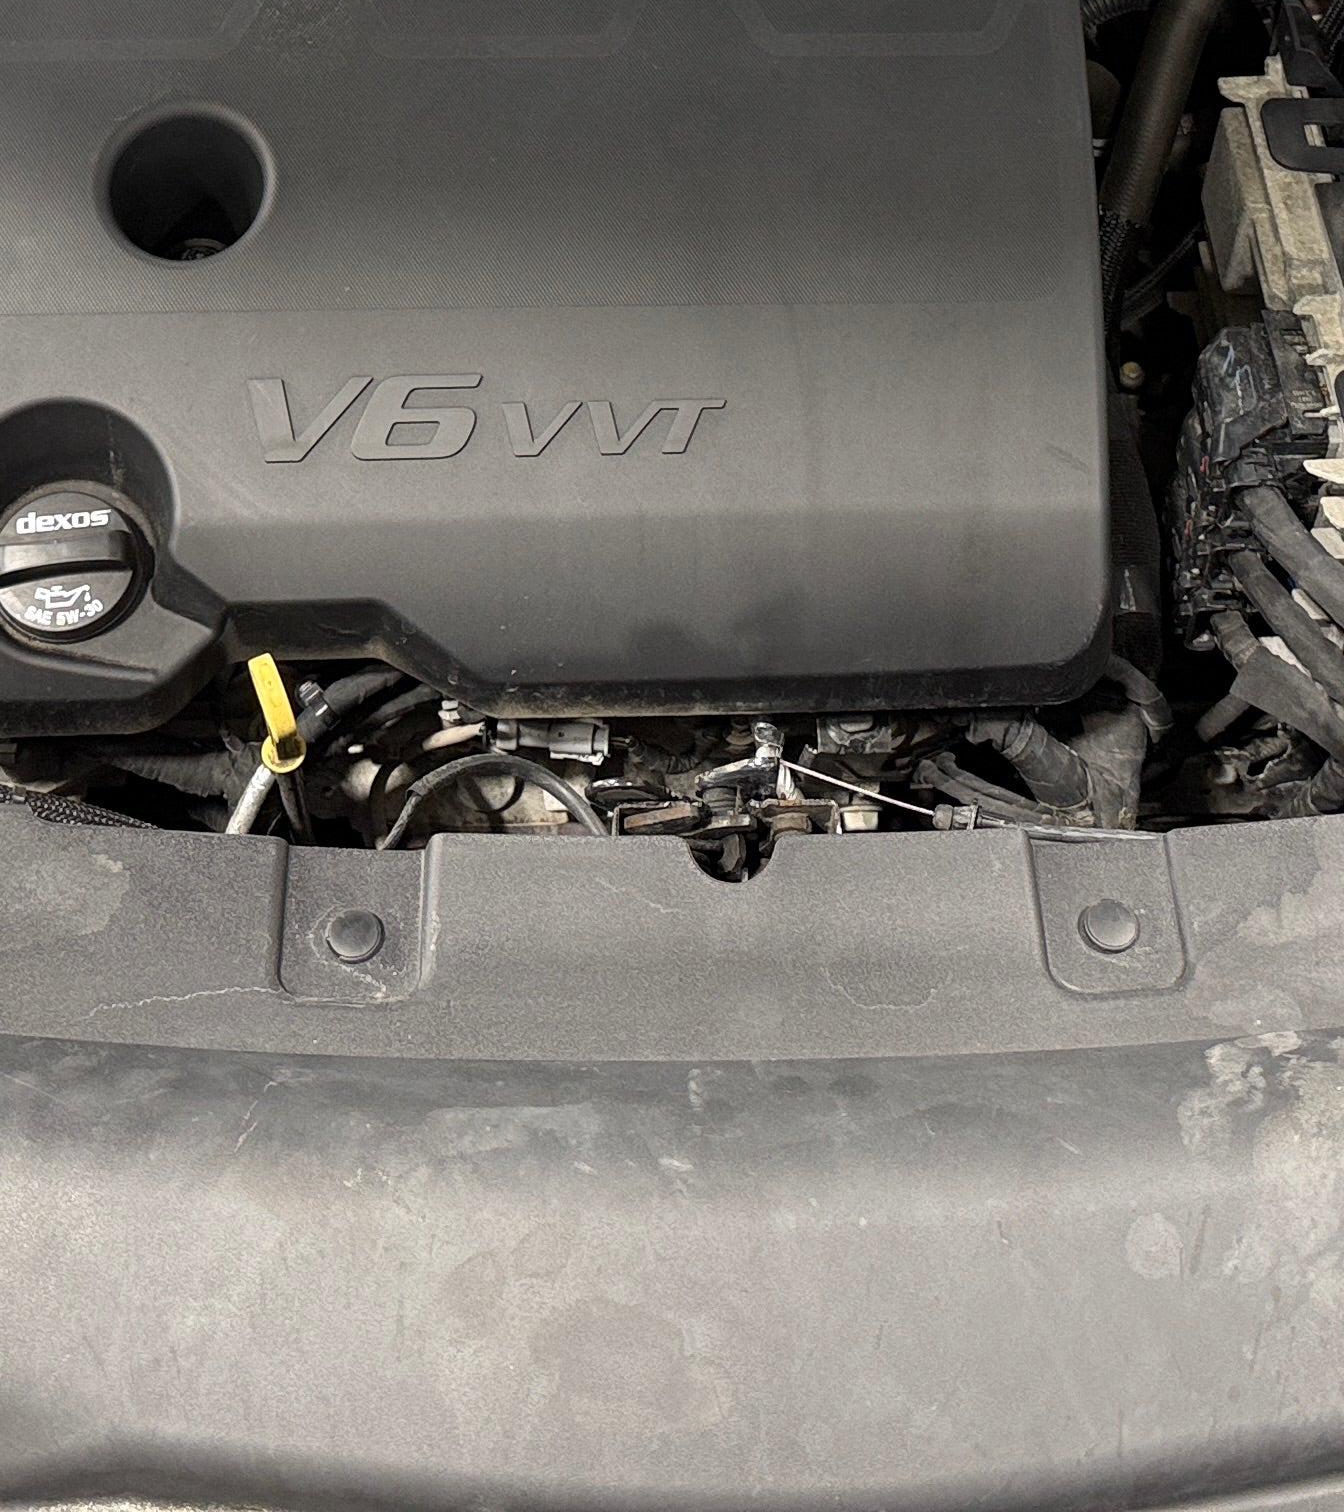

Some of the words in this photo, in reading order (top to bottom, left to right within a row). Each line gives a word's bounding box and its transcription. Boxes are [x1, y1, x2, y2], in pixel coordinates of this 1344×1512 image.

[247, 372, 483, 463] V6
[502, 397, 727, 457] VVT
[16, 509, 112, 534] dexos
[24, 606, 53, 626] SAE
[56, 600, 104, 626] 5W-30
